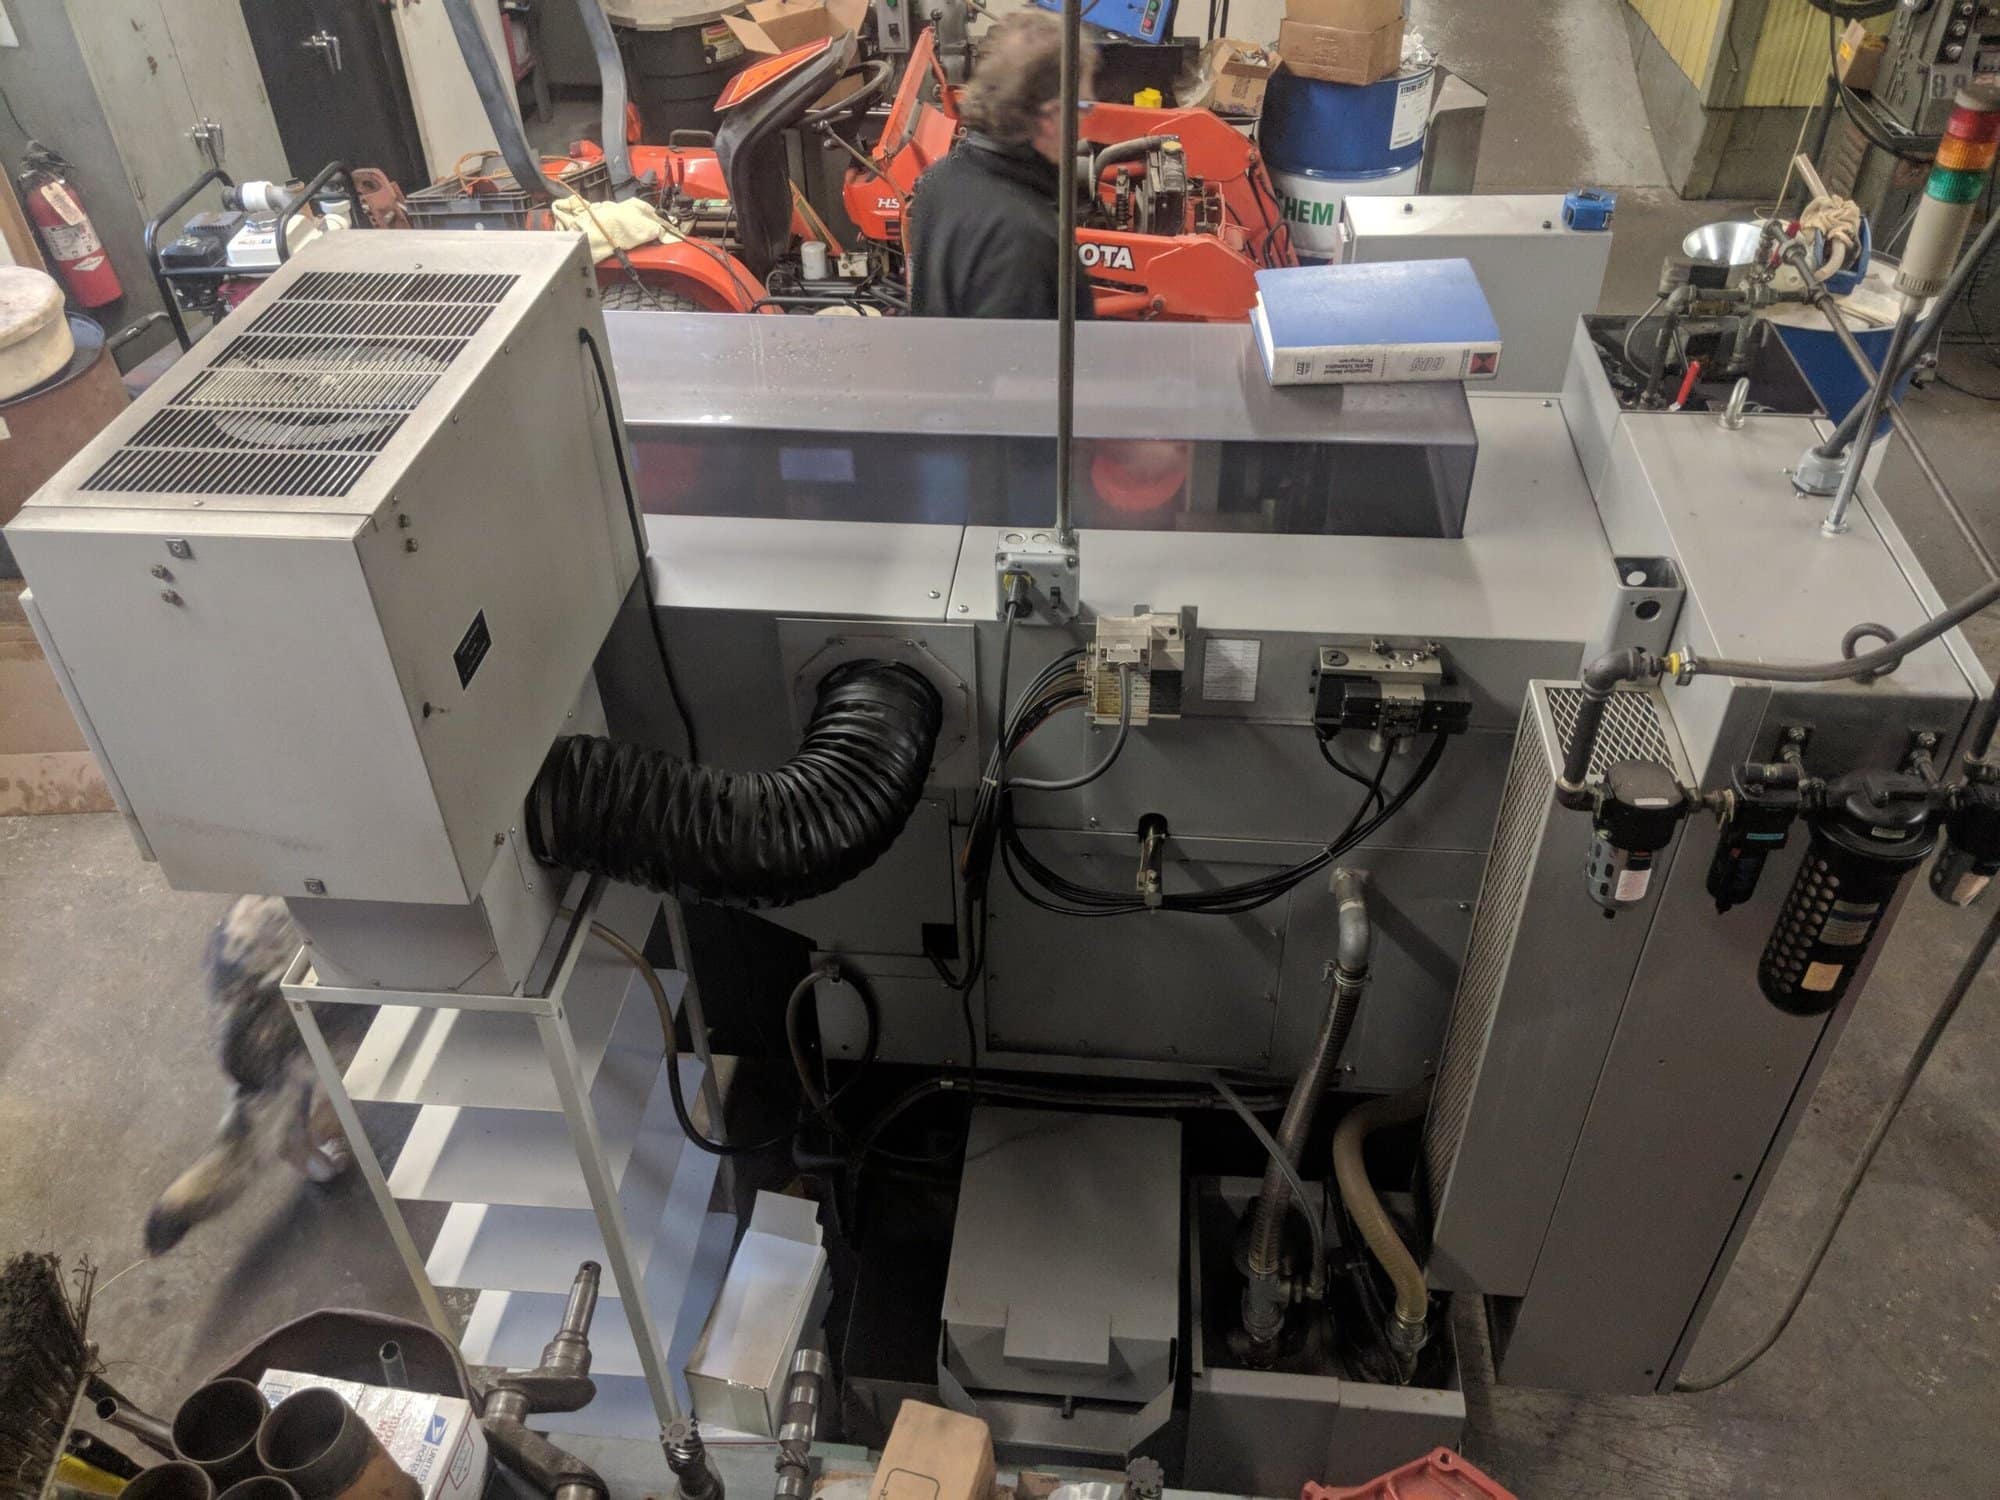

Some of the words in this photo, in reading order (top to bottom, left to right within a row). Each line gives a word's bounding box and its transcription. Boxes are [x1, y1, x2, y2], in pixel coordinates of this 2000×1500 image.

[1078, 241, 1136, 272] OTA
[409, 1443, 428, 1473] POSTA
[419, 1447, 439, 1482] UNITED
